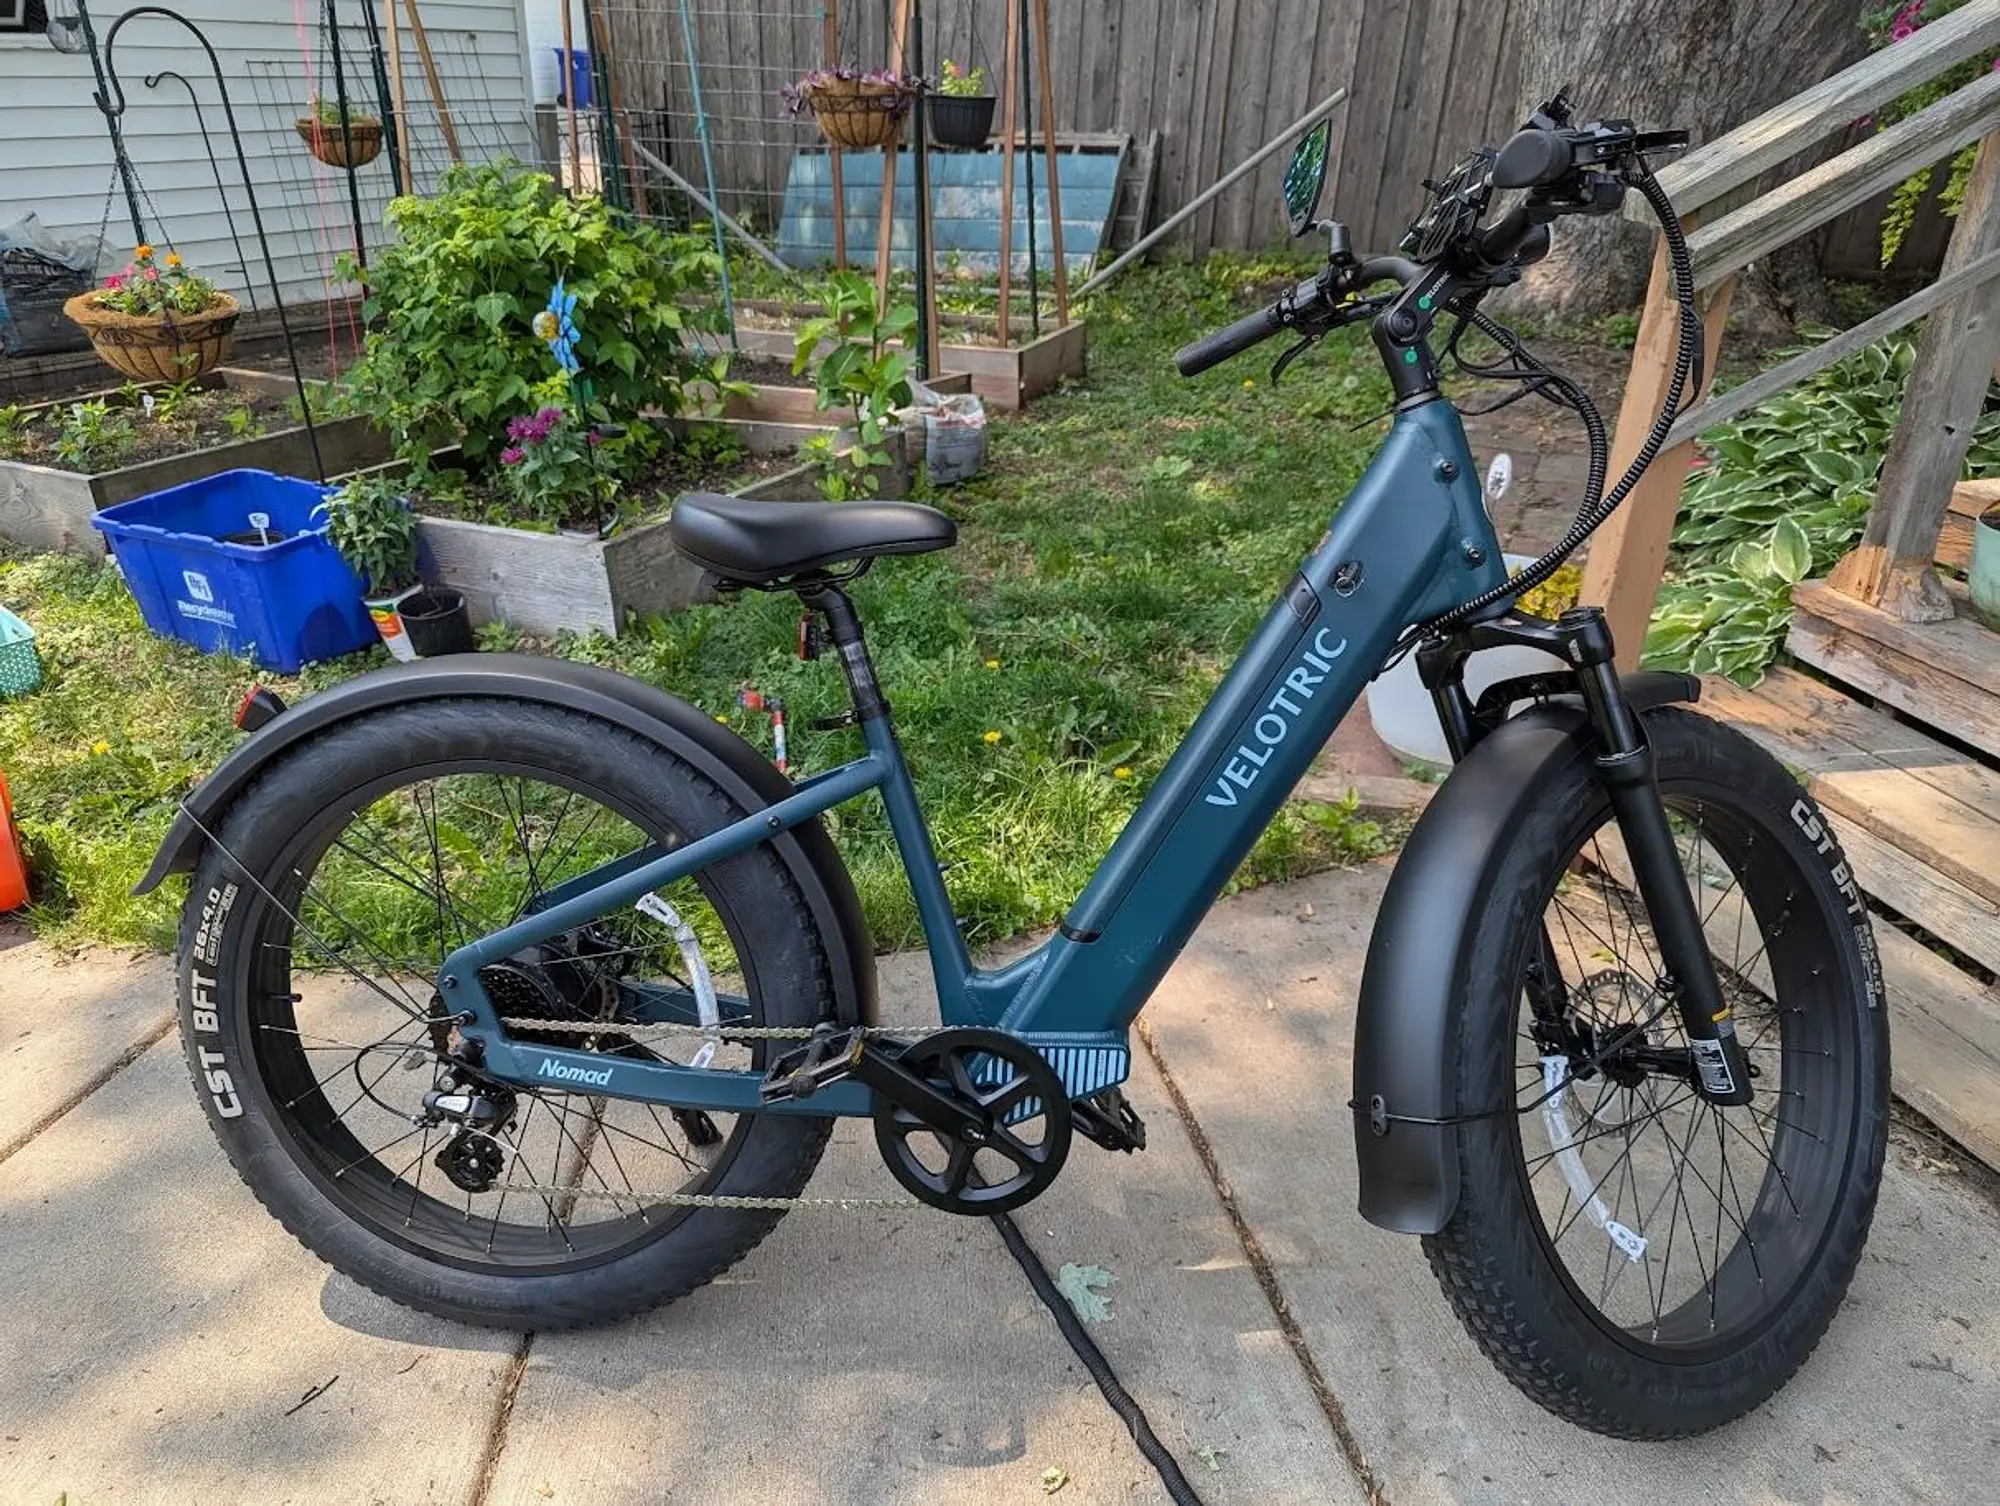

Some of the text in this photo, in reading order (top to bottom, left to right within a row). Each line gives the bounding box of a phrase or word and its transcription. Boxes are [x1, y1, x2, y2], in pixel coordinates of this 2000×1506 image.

[1423, 270, 1451, 300] ELOTRIC
[1204, 626, 1349, 807] VELOTRIC
[1790, 798, 1836, 855] CST
[1830, 860, 1865, 915] BFT
[191, 887, 244, 1119] CST BFT 26x4.0
[537, 1057, 614, 1087] Nomad
